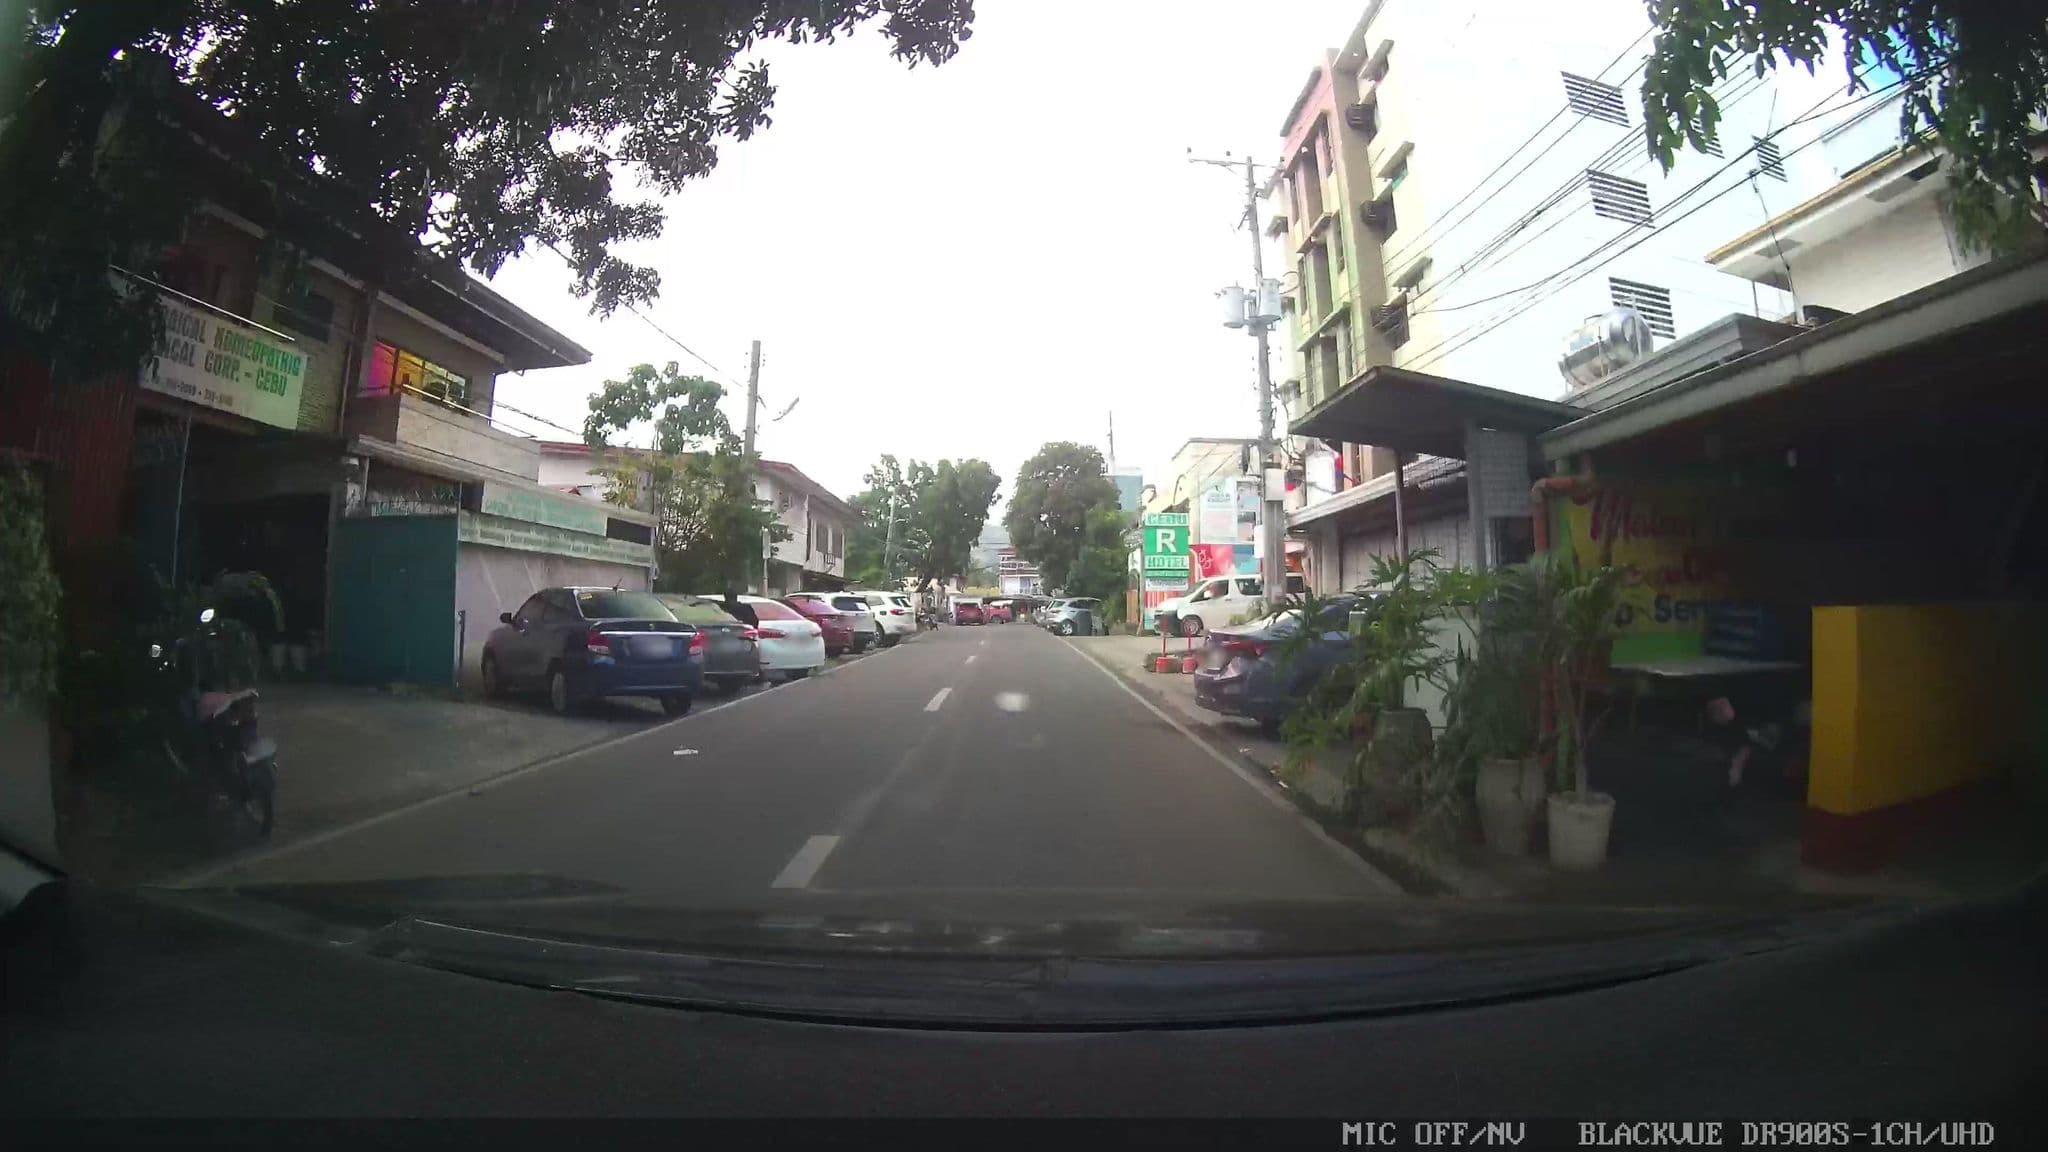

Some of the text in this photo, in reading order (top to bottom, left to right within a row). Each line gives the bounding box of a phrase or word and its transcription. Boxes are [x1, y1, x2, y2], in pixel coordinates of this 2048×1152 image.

[204, 349, 240, 383] CORP.
[255, 367, 288, 397] CEBU
[1146, 512, 1187, 524] CEBU
[1155, 528, 1177, 552] R
[1147, 556, 1187, 567] HOTEL
